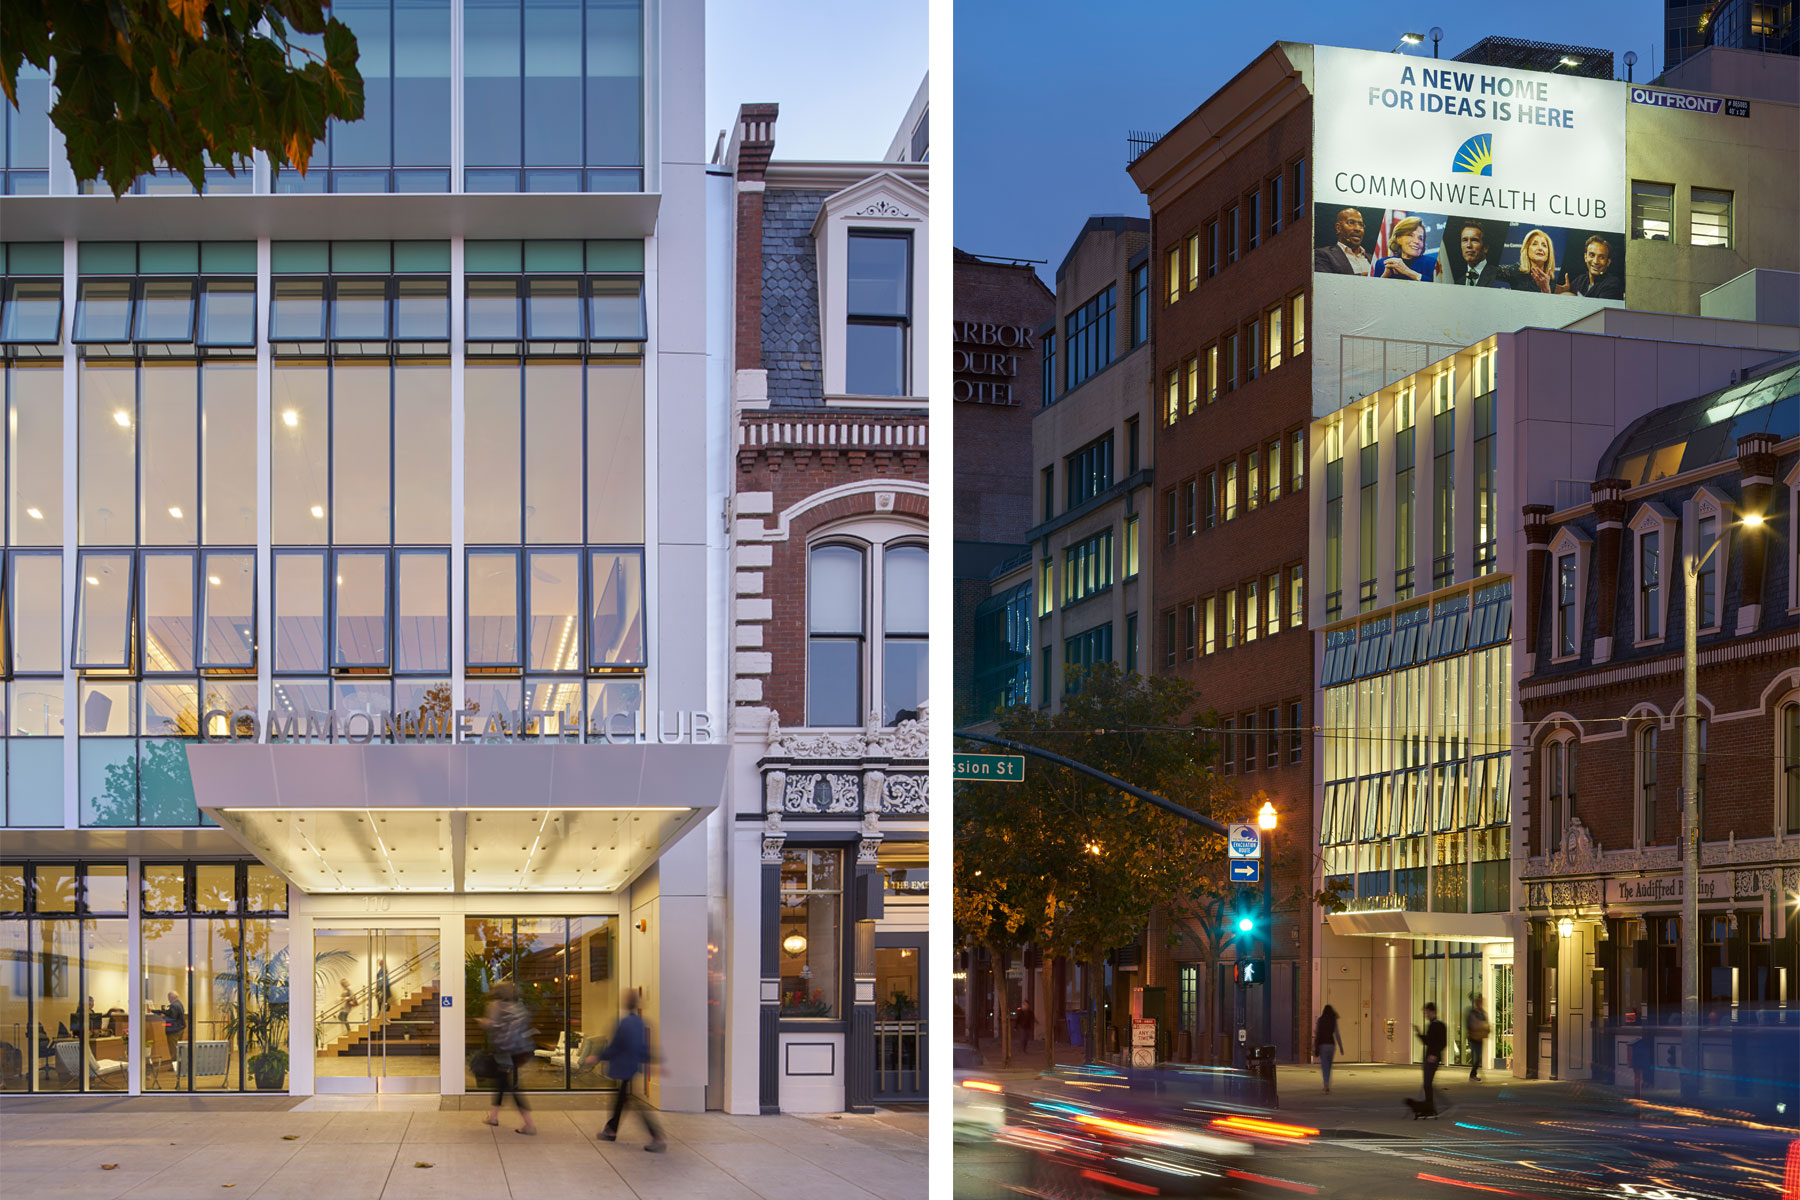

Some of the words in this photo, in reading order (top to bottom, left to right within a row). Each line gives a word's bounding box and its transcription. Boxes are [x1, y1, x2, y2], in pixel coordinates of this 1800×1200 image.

[1400, 66, 1416, 87] A
[1422, 68, 1475, 93] NEW
[1480, 75, 1548, 102] HOME
[1369, 86, 1414, 111] FOR
[1420, 92, 1487, 119] IDEAS
[1492, 101, 1512, 122] IS
[1518, 104, 1575, 129] HERE
[1633, 89, 1718, 113] OUTFRONT
[1335, 172, 1536, 212] COMMONWEALTH
[1549, 194, 1607, 219] CLUB
[953, 379, 1023, 406] OTEL
[202, 709, 585, 745] COMMONWEALTH
[605, 709, 715, 745] CLUB
[996, 761, 1013, 775] St
[891, 881, 909, 890] THE
[1619, 881, 1634, 901] The
[362, 895, 391, 912] 110
